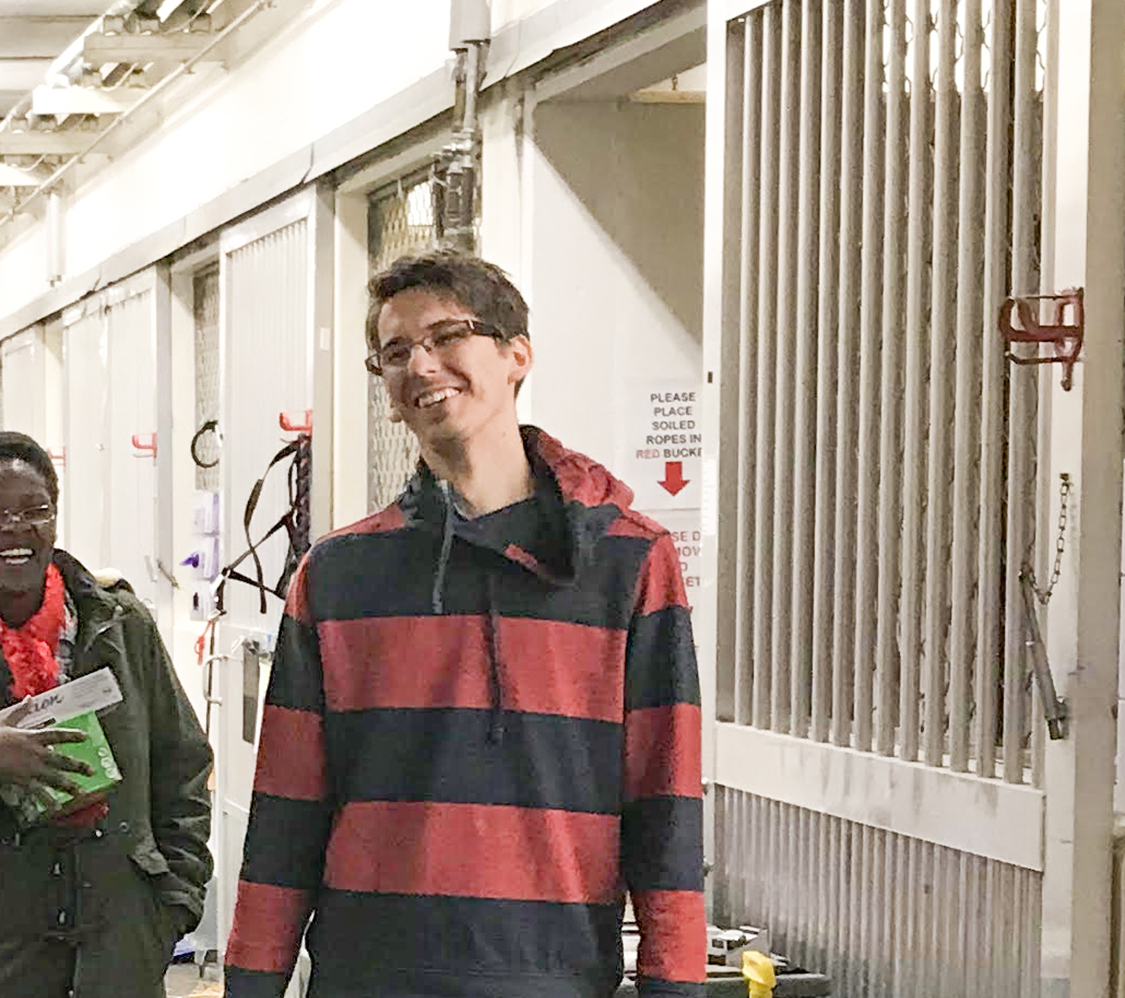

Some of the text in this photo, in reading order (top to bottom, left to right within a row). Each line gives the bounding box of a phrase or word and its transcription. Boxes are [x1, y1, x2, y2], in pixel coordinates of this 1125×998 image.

[650, 392, 696, 403] PLEASE
[654, 406, 692, 417] PLACE
[652, 420, 695, 431] SOILED
[646, 434, 702, 445] ROPES IN
[636, 448, 660, 459] RED
